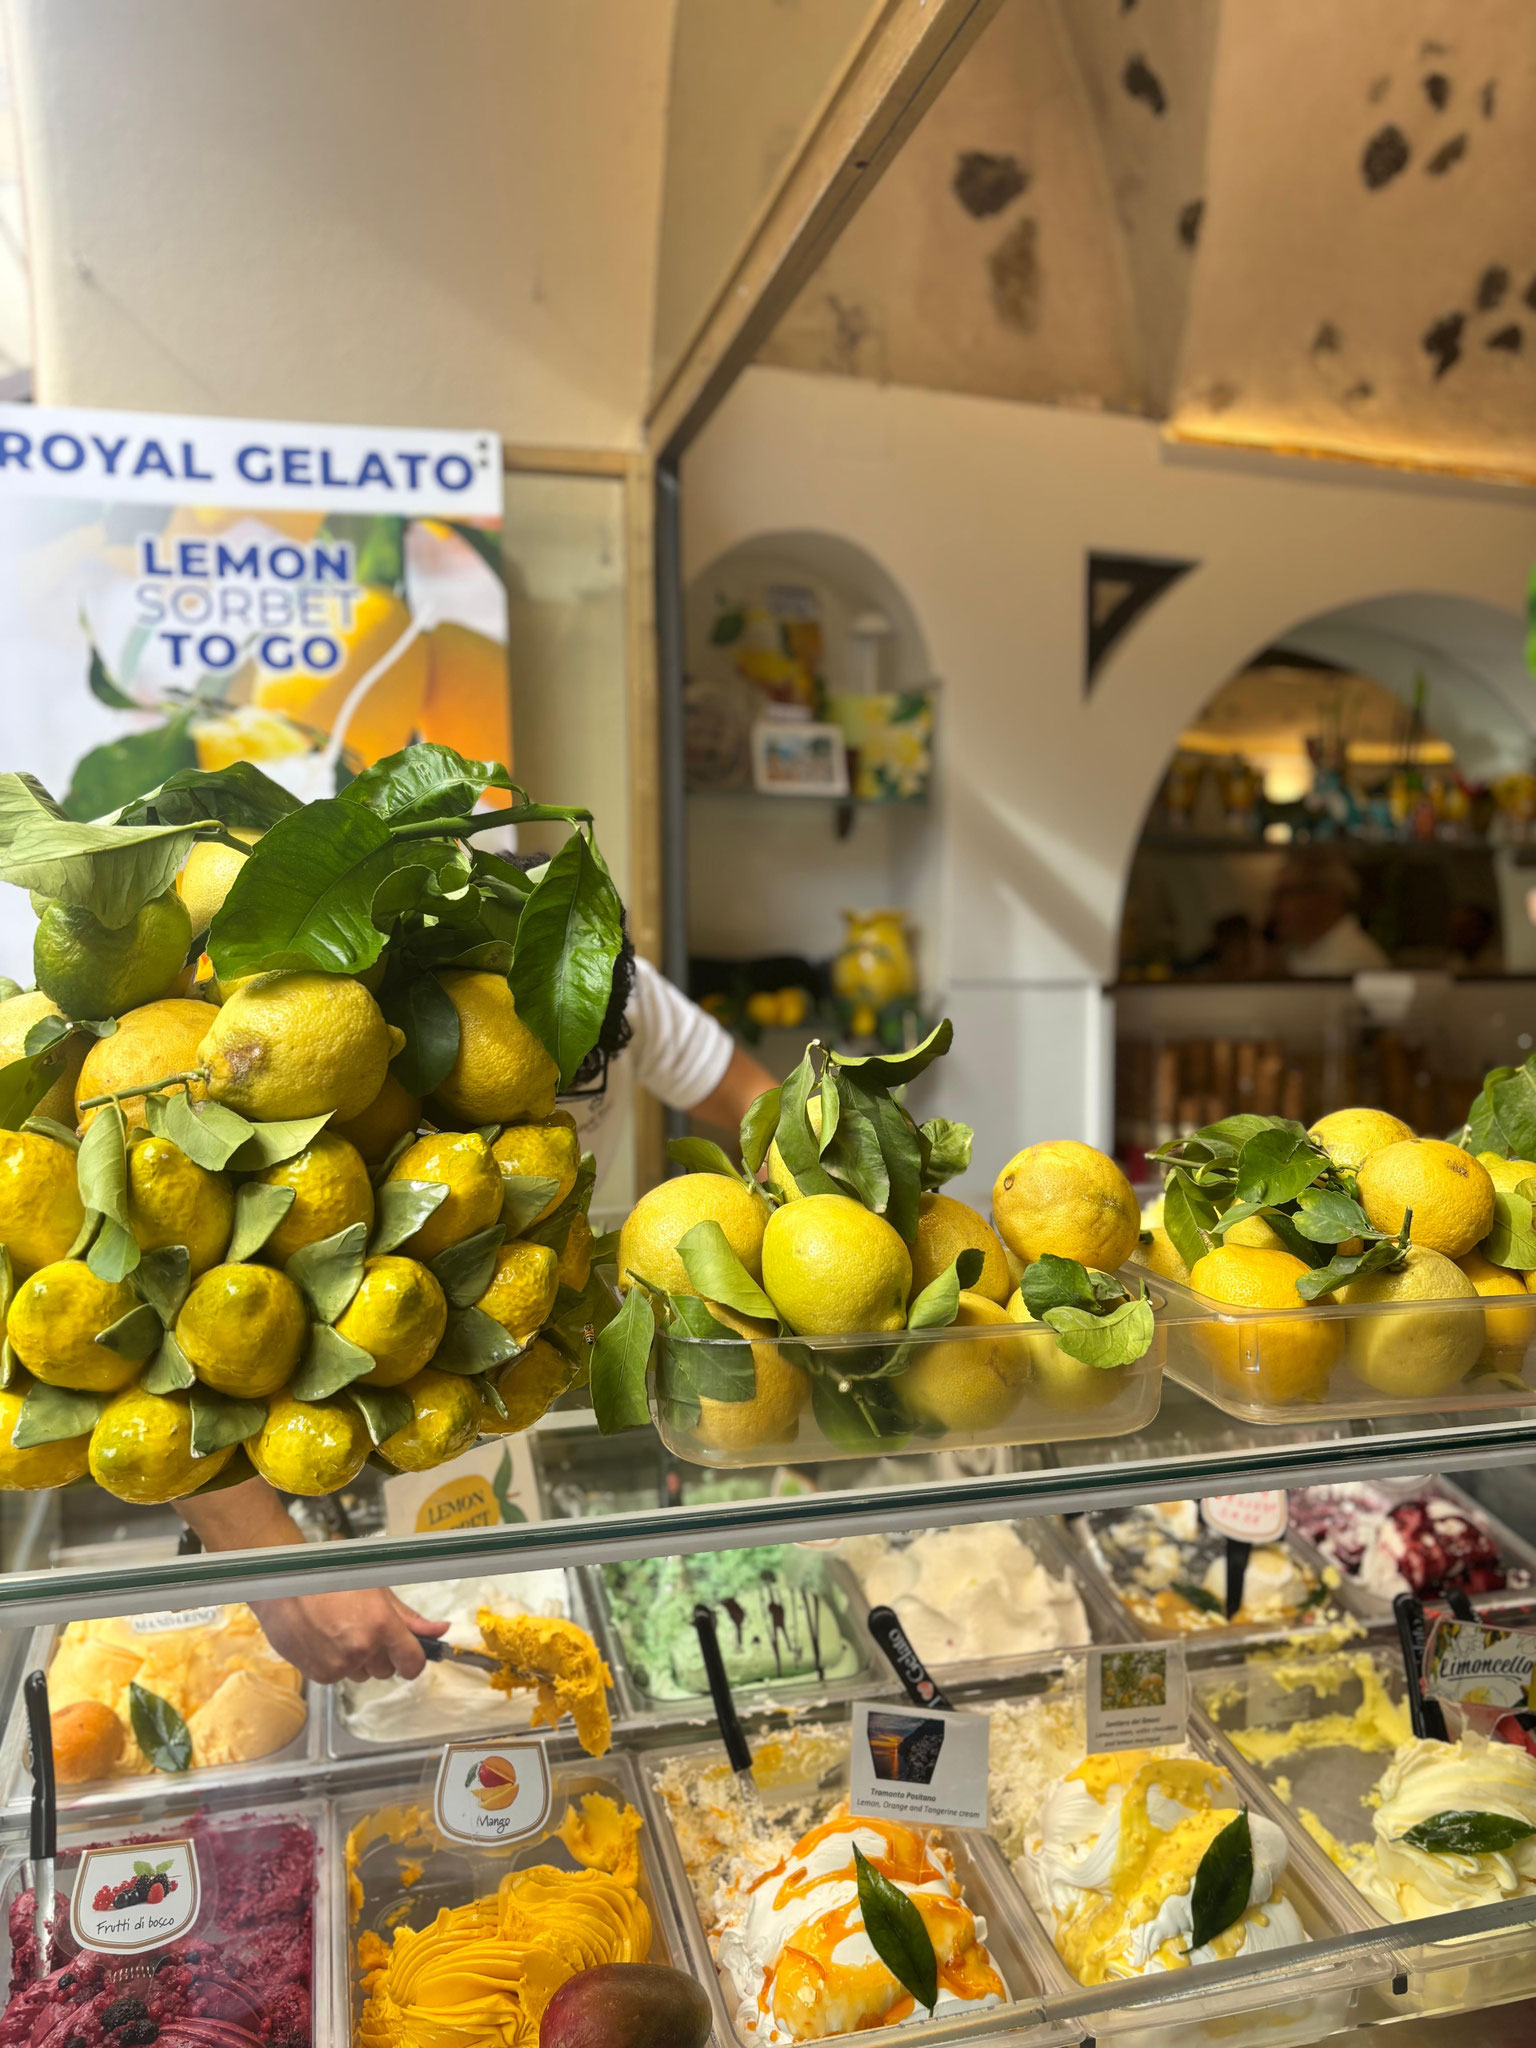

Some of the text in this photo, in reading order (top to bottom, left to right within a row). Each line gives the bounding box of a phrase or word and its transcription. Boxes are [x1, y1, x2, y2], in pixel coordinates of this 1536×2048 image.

[0, 430, 474, 491] ROYAL GELATO
[144, 541, 349, 581] LEMON
[135, 583, 360, 629] SORBET
[160, 632, 339, 670] TO GO
[427, 1490, 485, 1526] LEMON
[1440, 1655, 1534, 1678] Limoncello
[857, 1797, 980, 1819] Lemon, Orange and Tangerine cream
[870, 1787, 937, 1803] Tramonto Positano
[476, 1814, 511, 1835] Mango
[97, 1915, 175, 1935] Frutti di bosco
